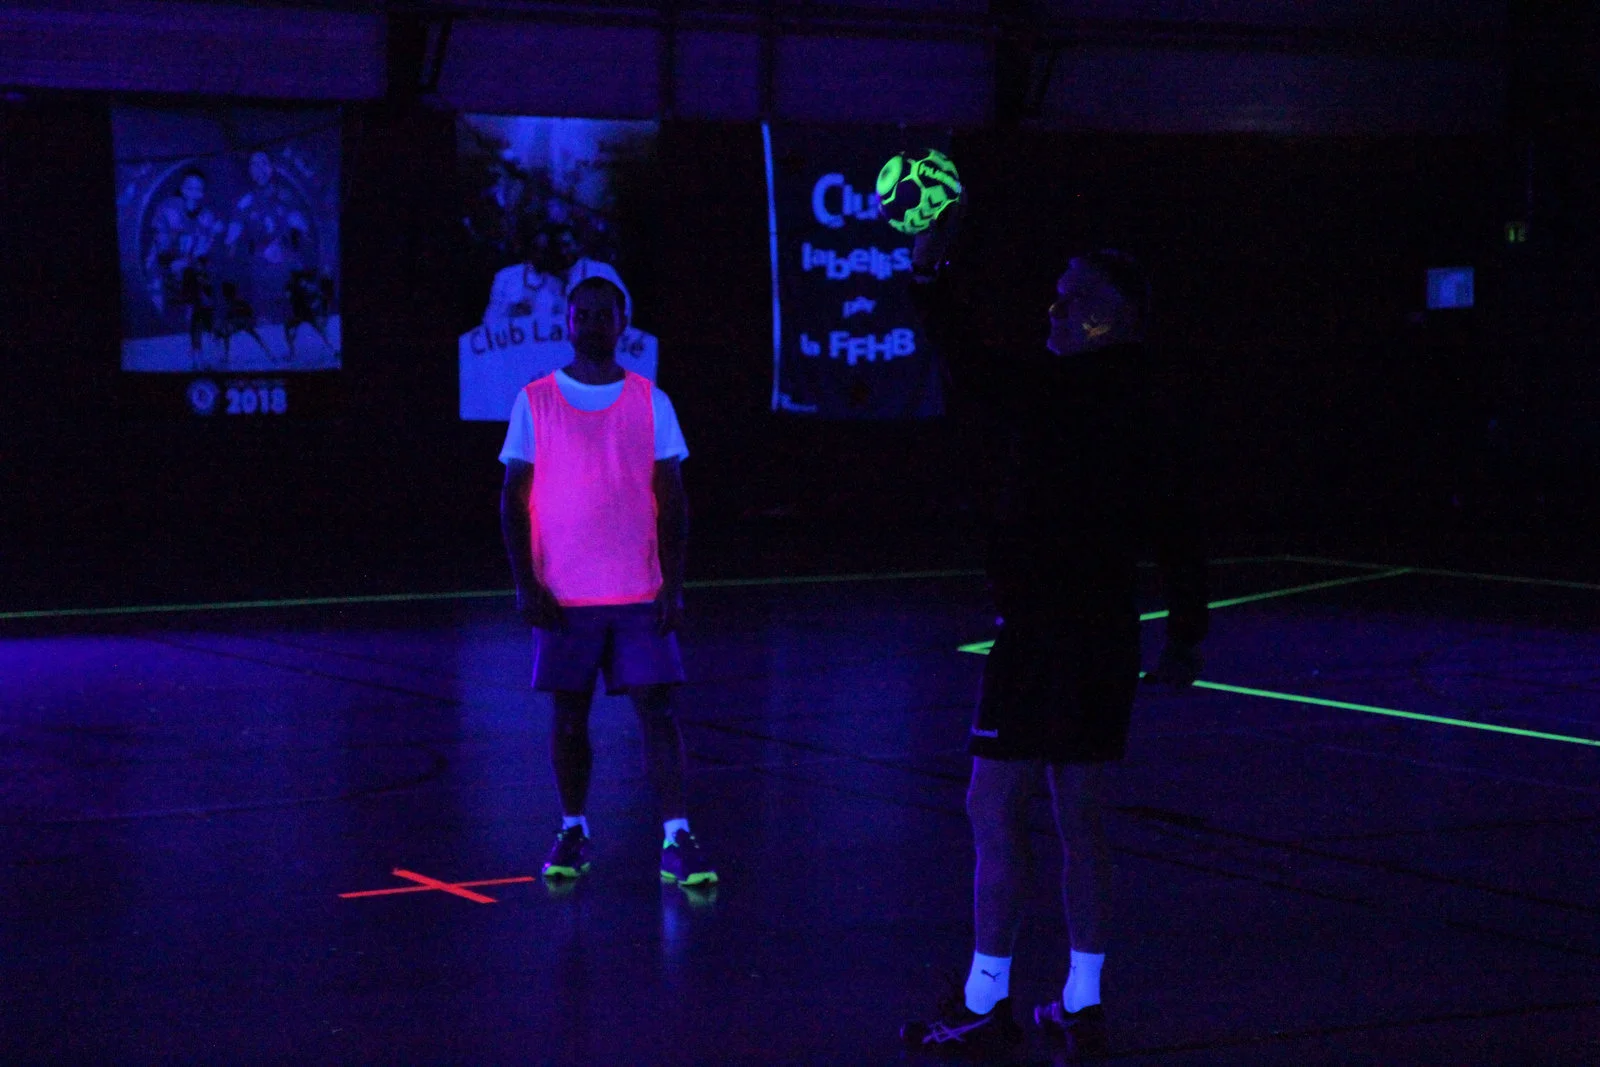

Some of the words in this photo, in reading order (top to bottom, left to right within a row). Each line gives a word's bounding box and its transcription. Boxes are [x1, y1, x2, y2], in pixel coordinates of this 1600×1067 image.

[812, 172, 880, 227] Clu
[801, 240, 913, 281] labellis
[471, 317, 524, 355] Club
[828, 326, 916, 366] FFHB
[225, 387, 287, 414] 2018
